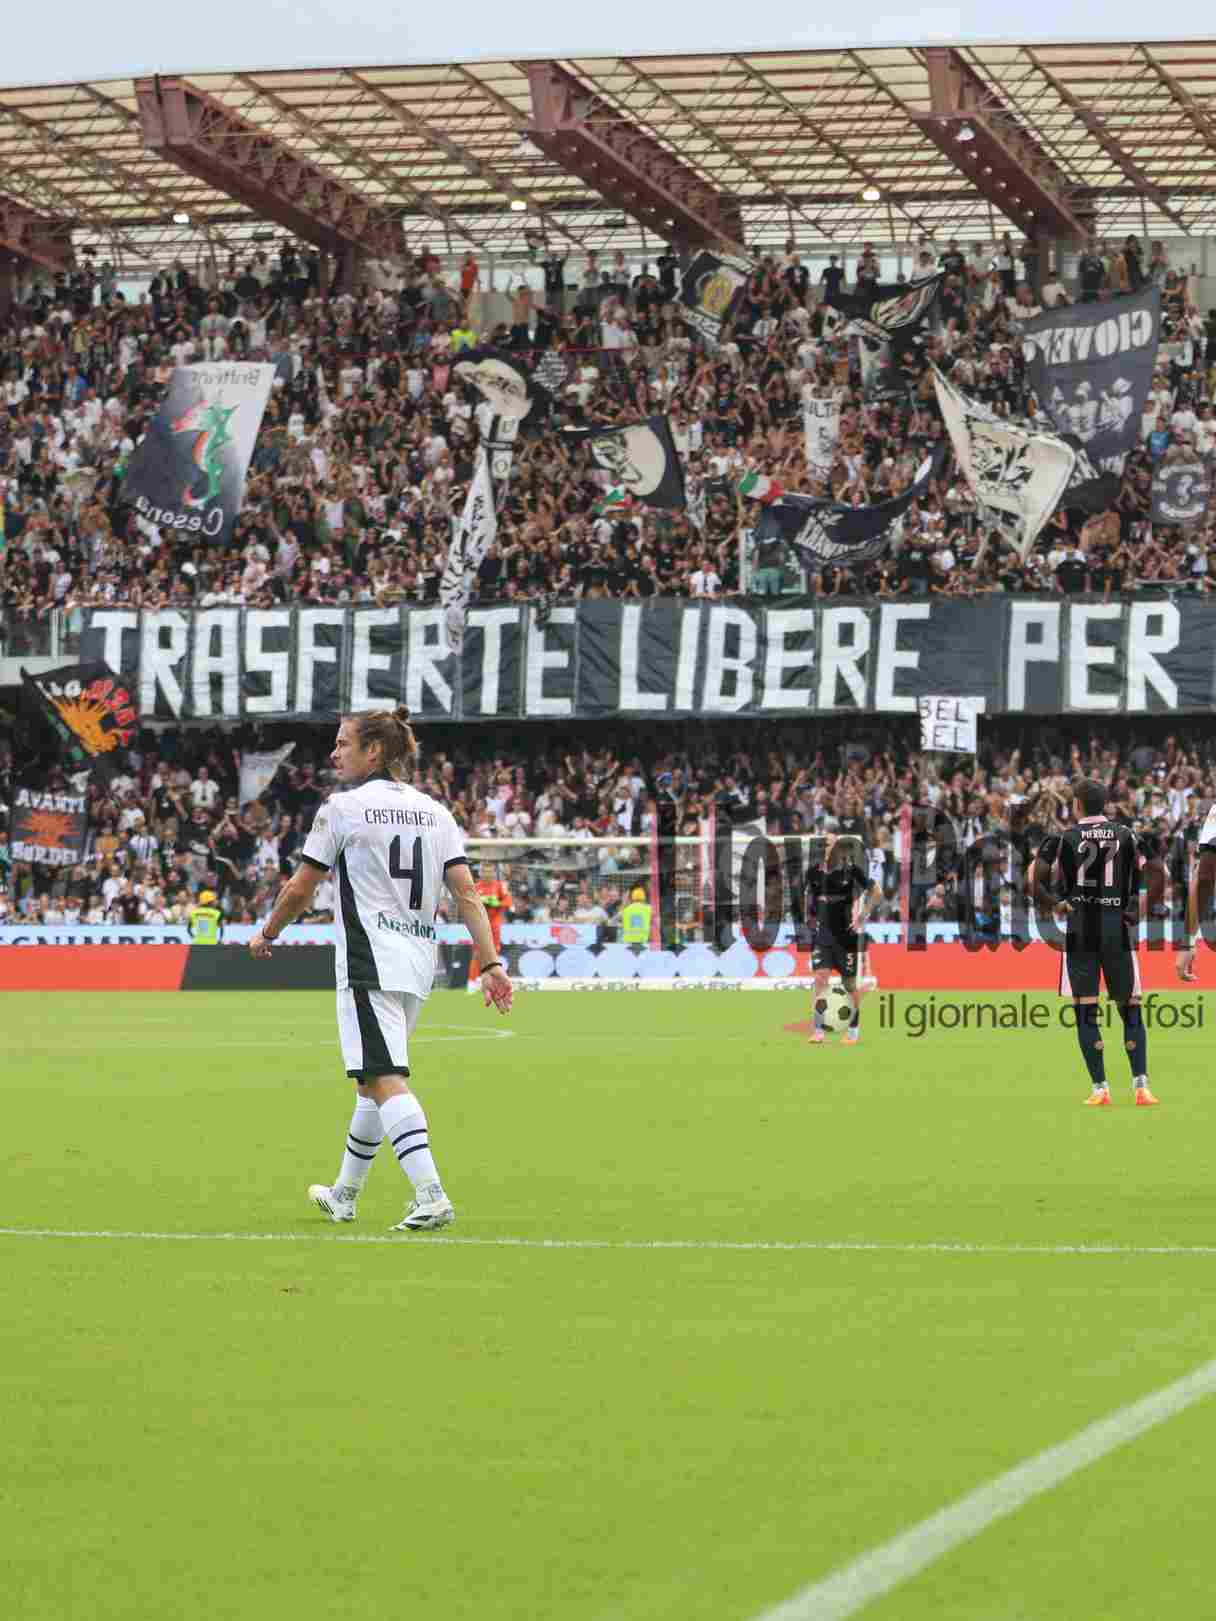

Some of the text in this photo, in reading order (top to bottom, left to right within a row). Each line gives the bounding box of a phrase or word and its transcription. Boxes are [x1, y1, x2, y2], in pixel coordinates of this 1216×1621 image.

[91, 607, 577, 719] TRASFERTE
[619, 601, 931, 713] LIBERE
[1006, 599, 1181, 710] PER
[389, 835, 424, 910] 4
[1076, 838, 1121, 888] 27
